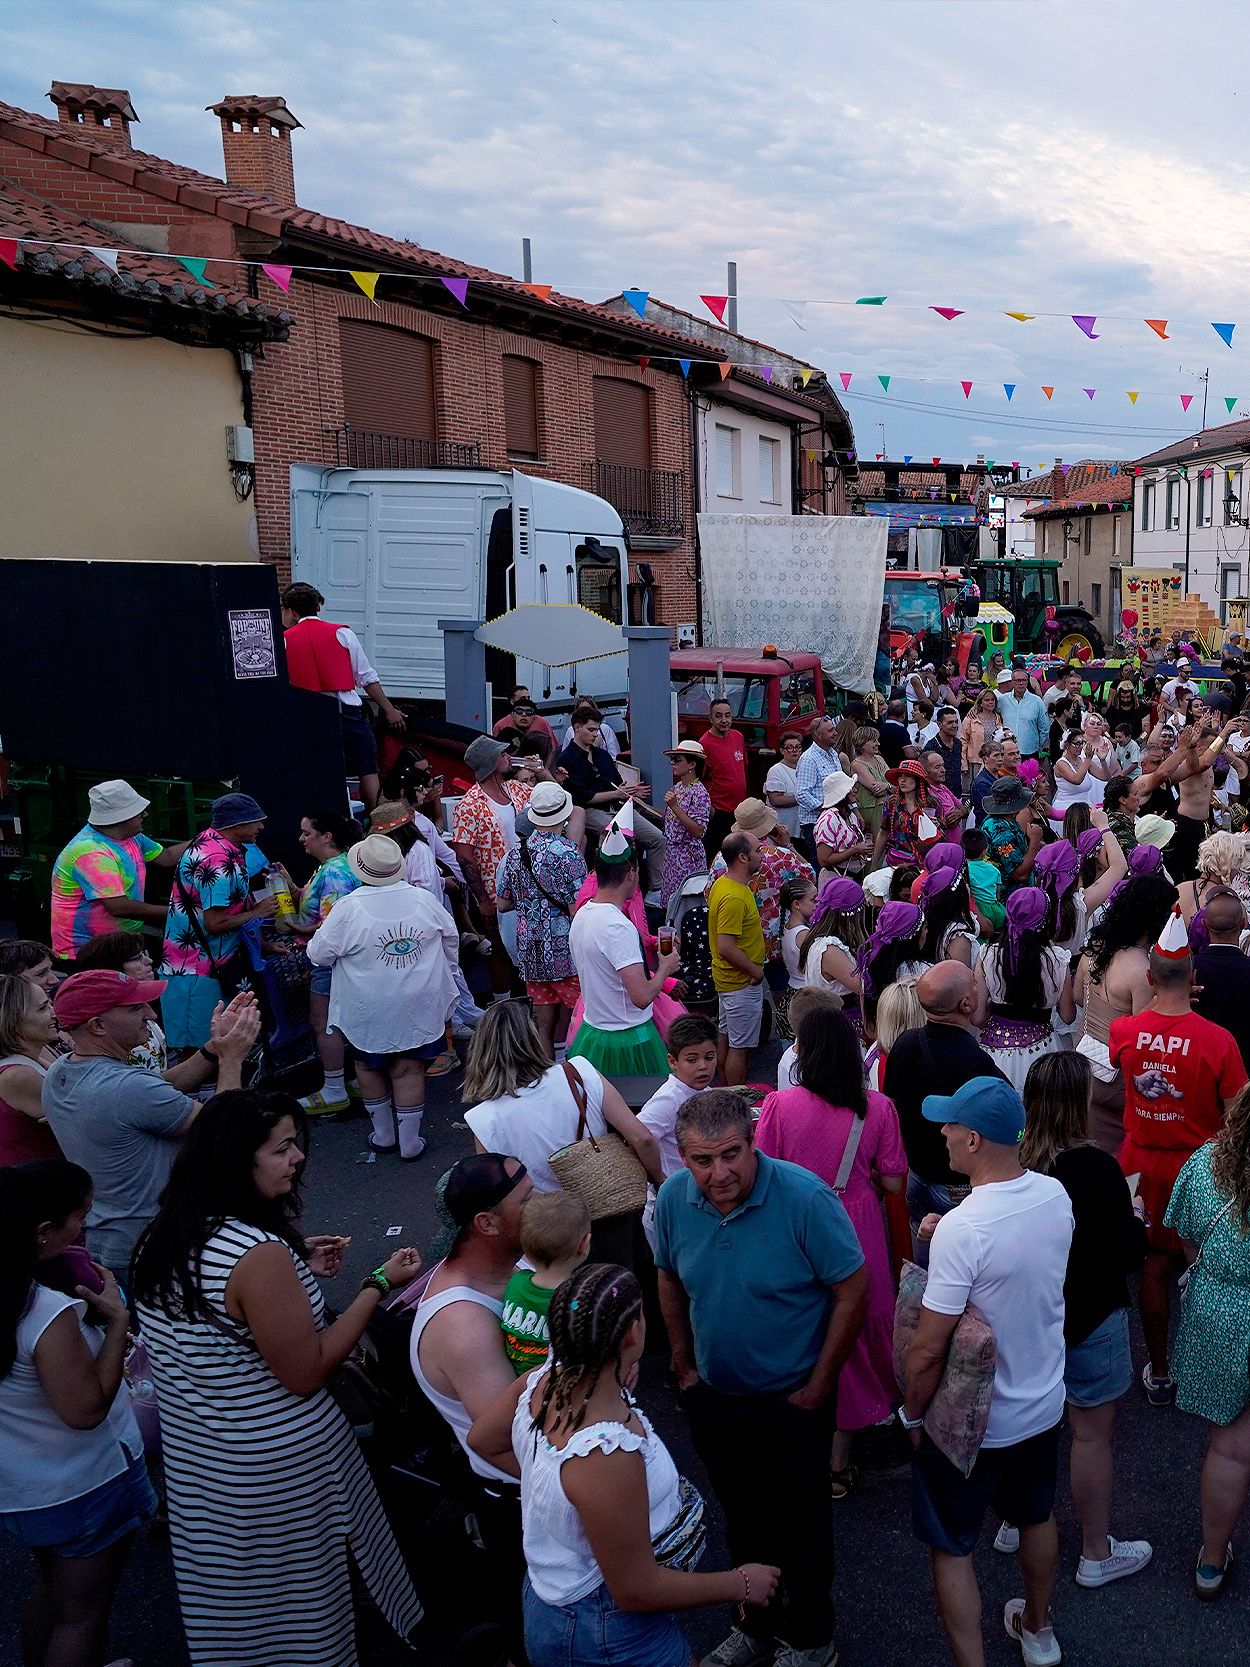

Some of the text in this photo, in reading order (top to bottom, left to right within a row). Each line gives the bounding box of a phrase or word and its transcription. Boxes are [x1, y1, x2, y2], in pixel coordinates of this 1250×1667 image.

[231, 619, 271, 636] FORUNE
[1136, 1031, 1191, 1056] PAPI
[1142, 1061, 1177, 1074] DANIELA
